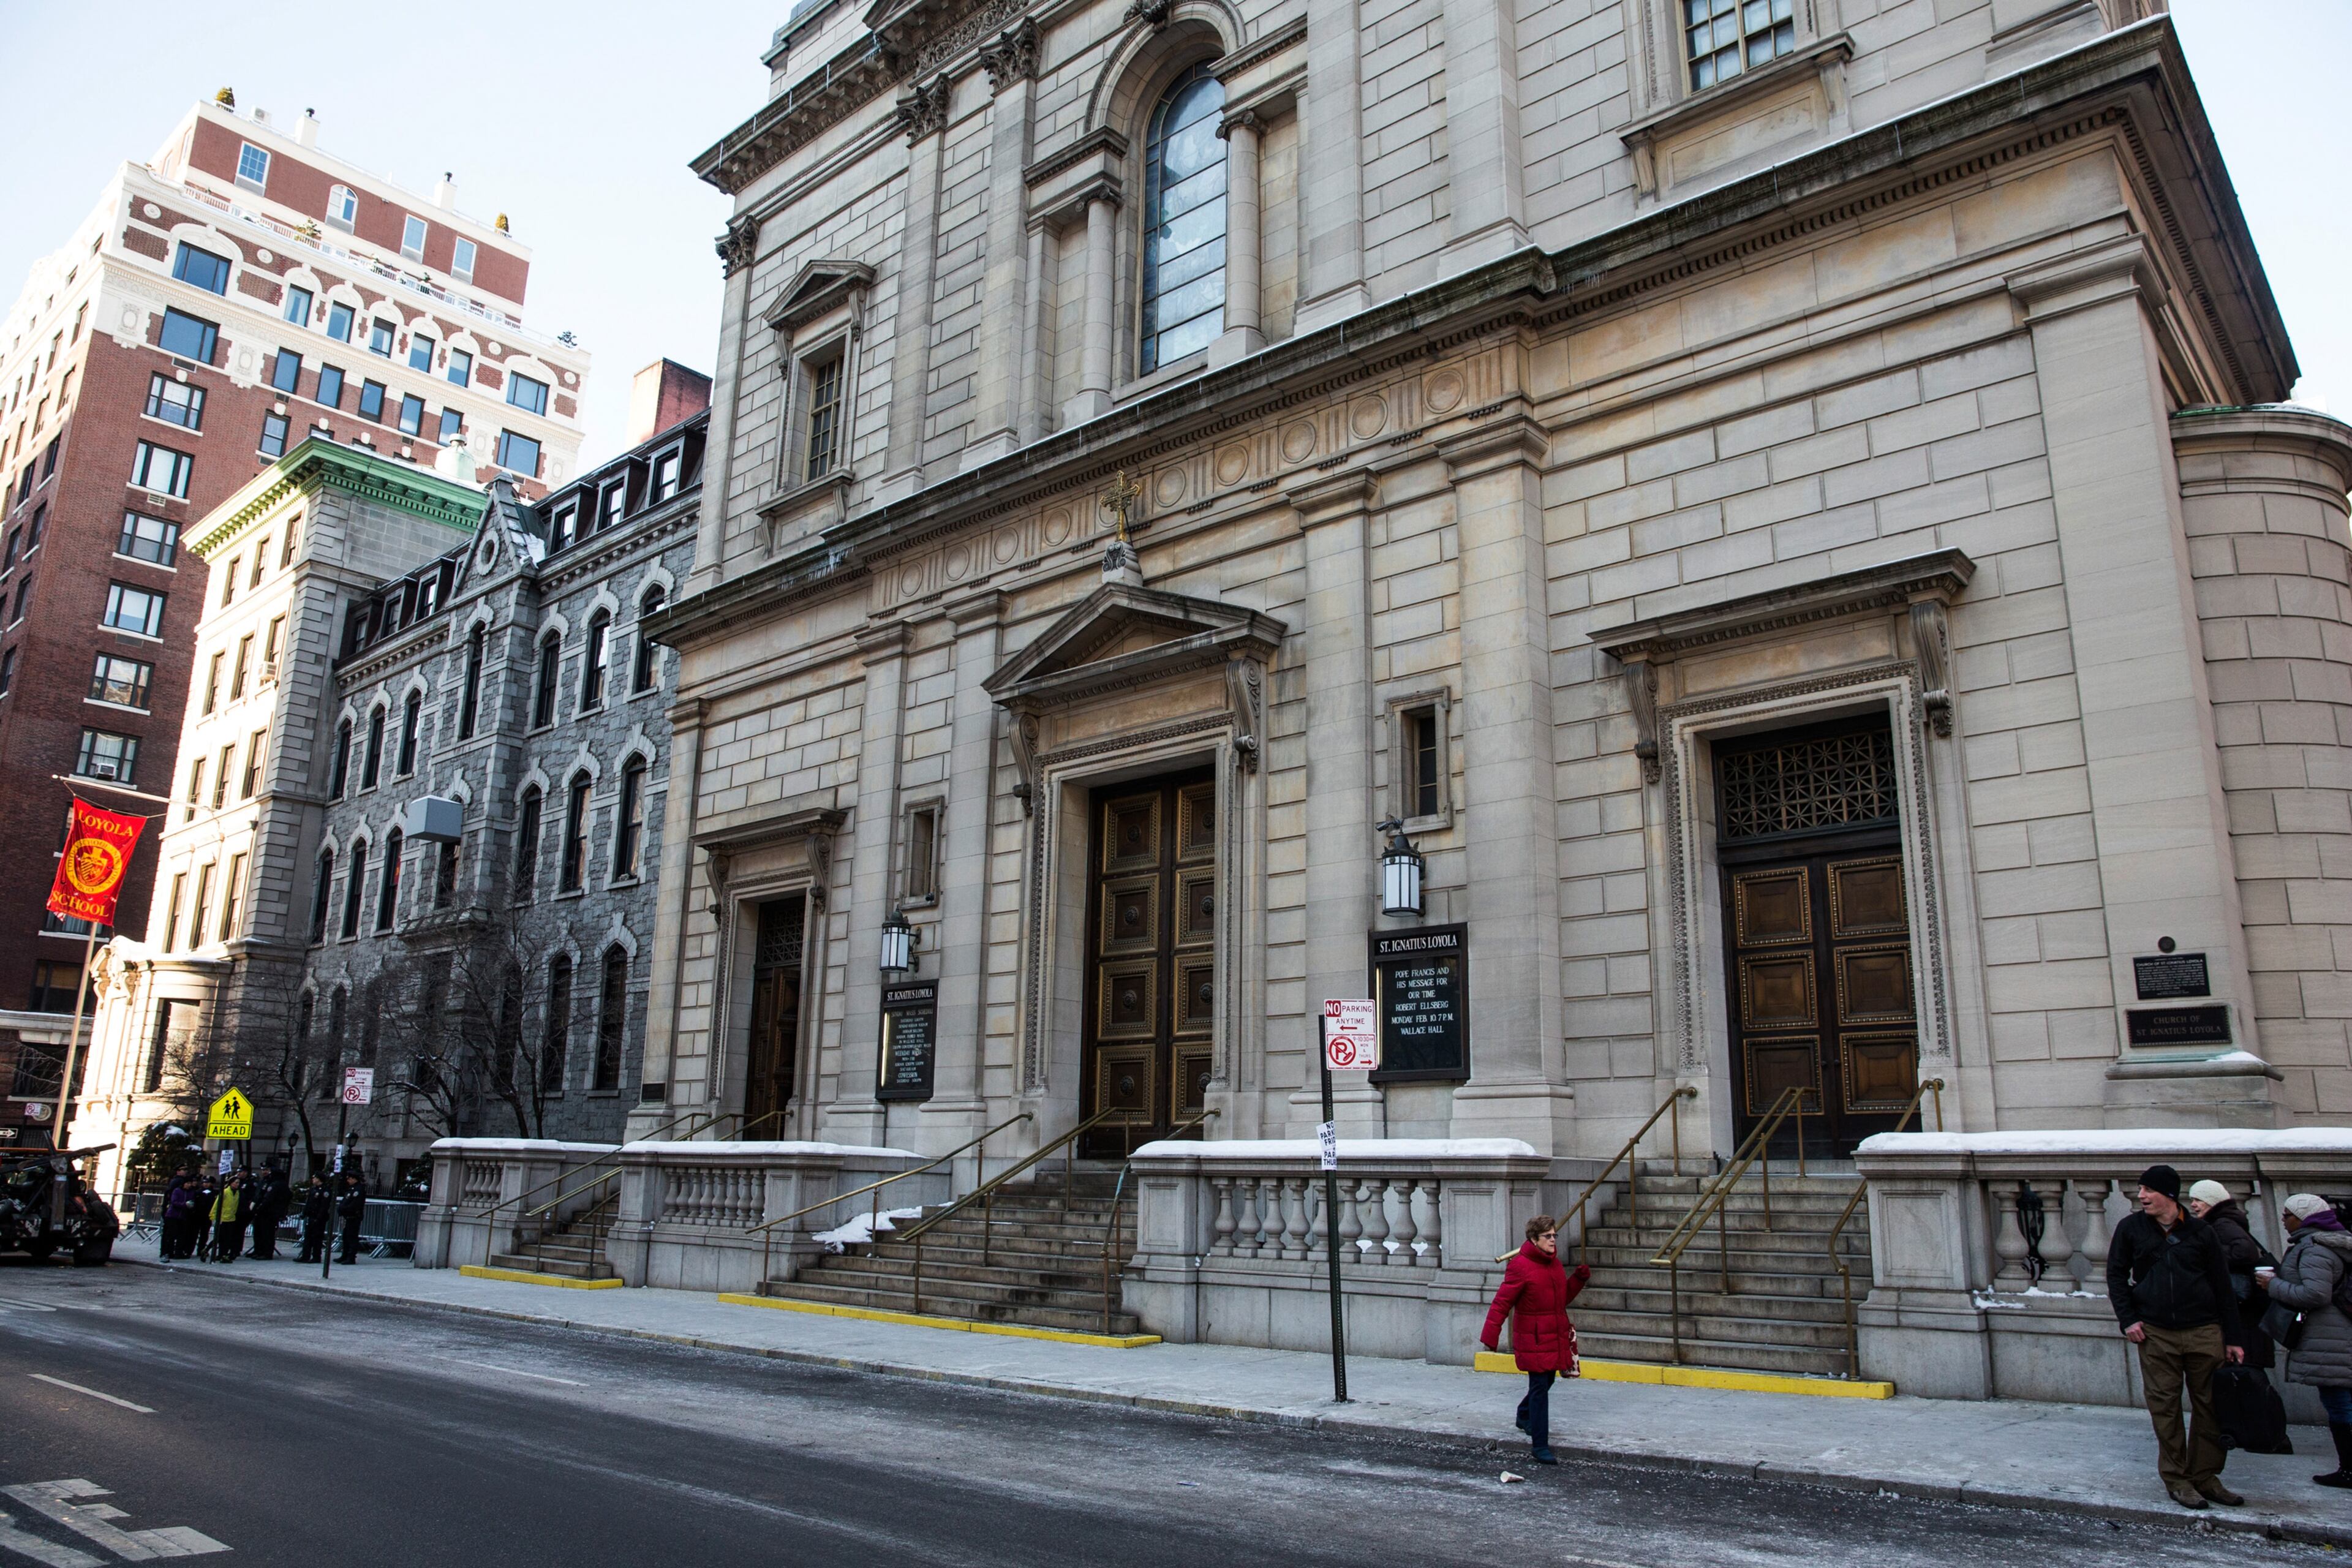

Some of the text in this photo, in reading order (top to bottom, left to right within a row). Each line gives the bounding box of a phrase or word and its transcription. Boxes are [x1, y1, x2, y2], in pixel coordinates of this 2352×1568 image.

[78, 810, 134, 837] LOYOLA
[51, 891, 109, 917] SCHOOL
[1380, 934, 1457, 952] ST. IGNATIUS LOYOLA
[1395, 970, 1409, 978] POPE
[1411, 968, 1434, 977] FRANCIS
[1408, 978, 1434, 987] MESSAGE
[895, 989, 915, 1000] IGNATIUS
[916, 988, 933, 998] LOYOLA
[1422, 990, 1436, 998] TIME
[1326, 1003, 1340, 1015] NO
[1395, 1000, 1449, 1011] ROBERT ELLSBERG
[1400, 1027, 1426, 1035] WALLACE
[1325, 1121, 1334, 1130] NO
[212, 1126, 246, 1136] AHEAD
